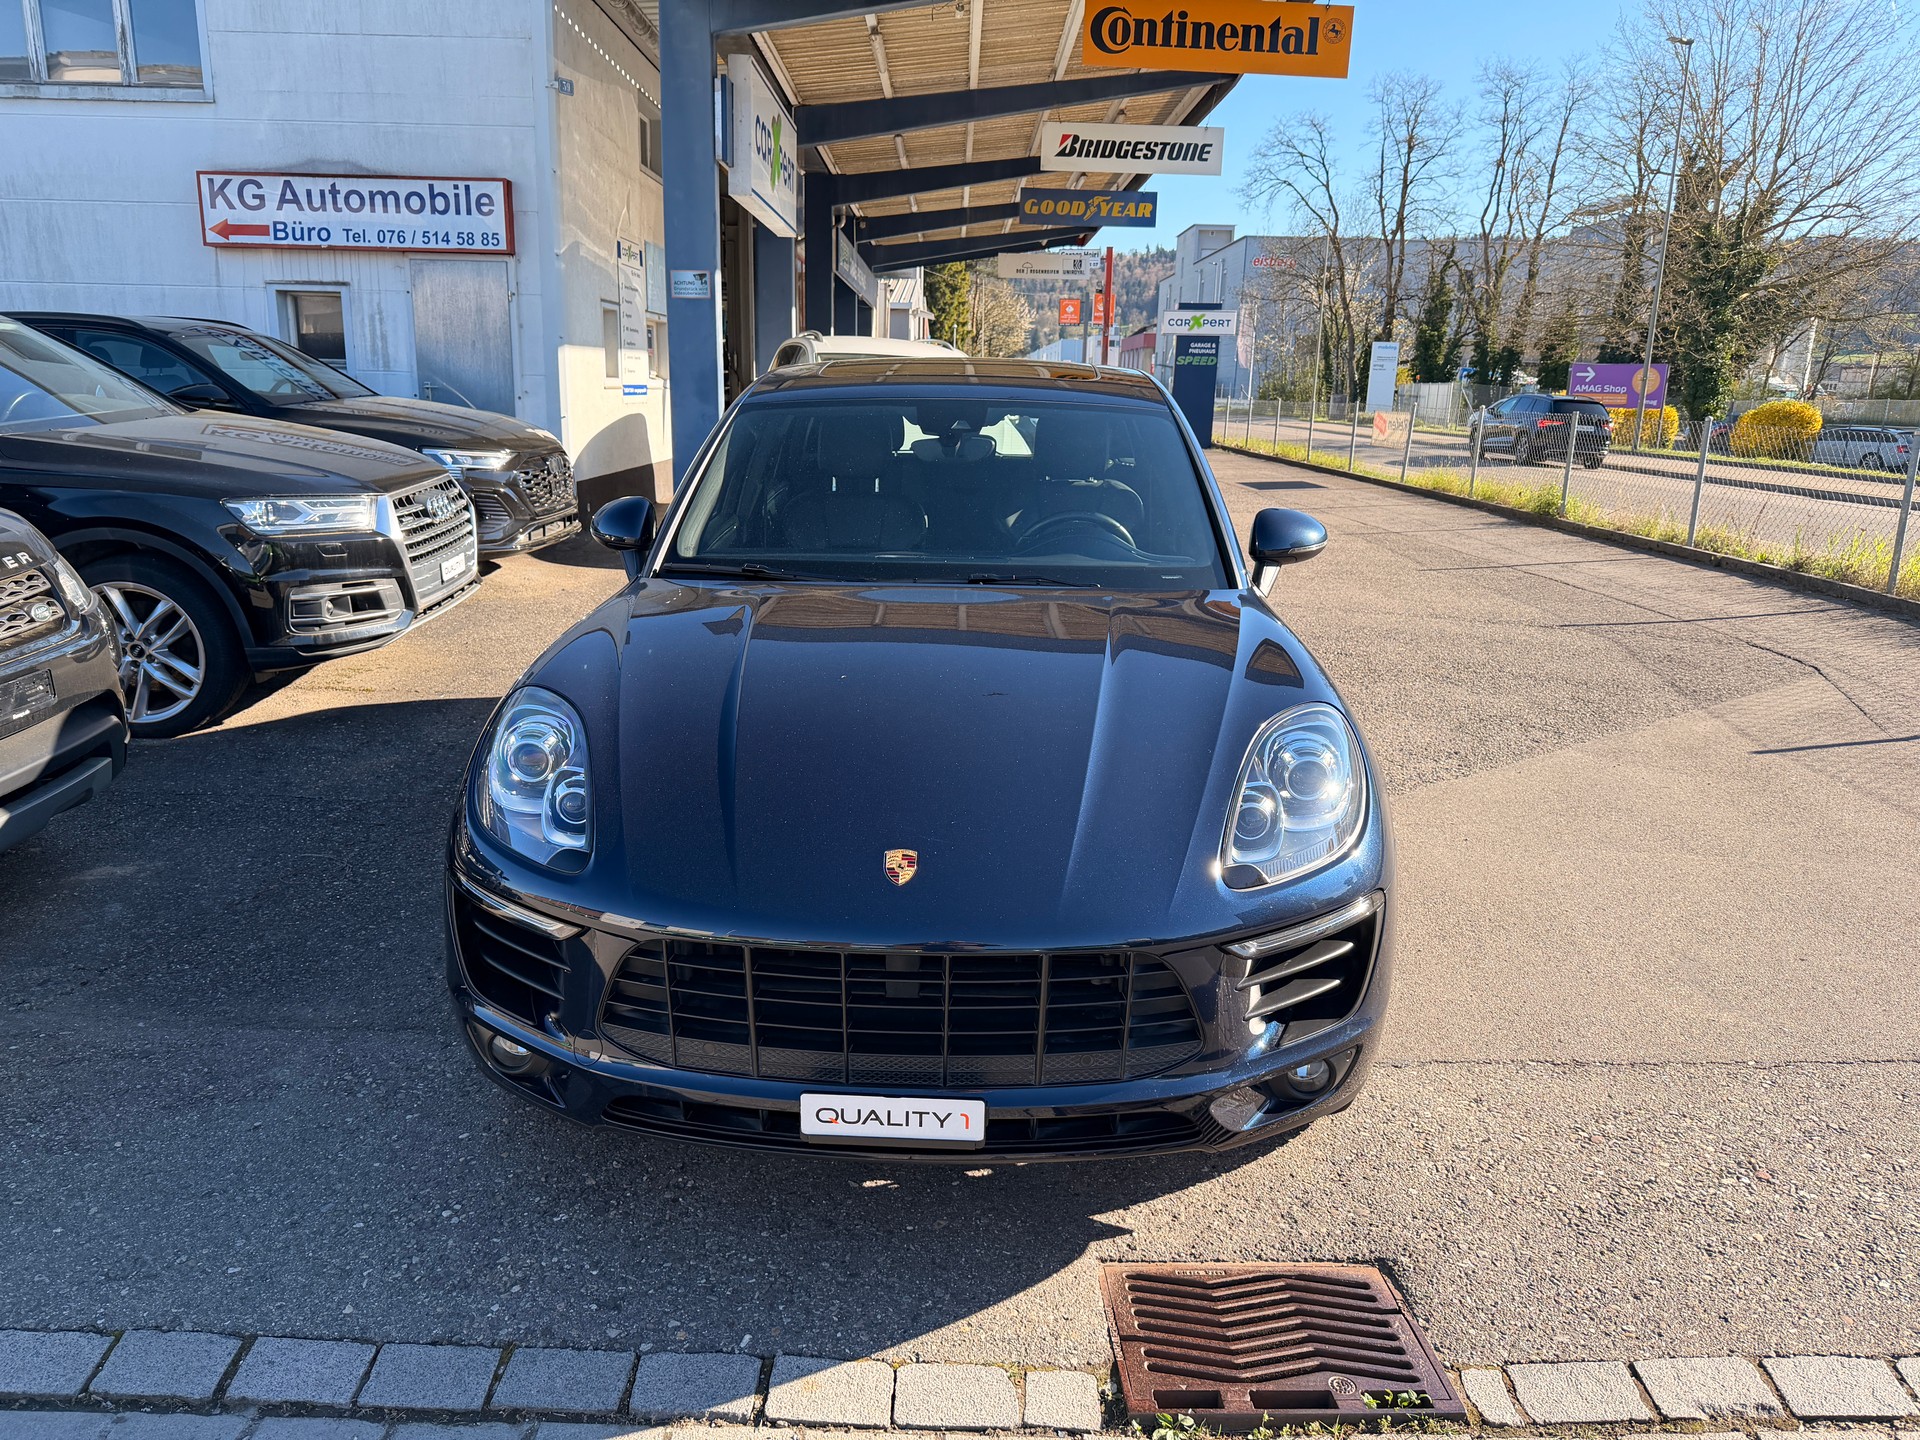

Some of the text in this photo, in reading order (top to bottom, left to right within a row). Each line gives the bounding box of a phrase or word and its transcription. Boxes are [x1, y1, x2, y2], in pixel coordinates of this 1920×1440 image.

[1090, 6, 1320, 55] Continental
[1054, 133, 1213, 162] BRIDGESTONE
[207, 178, 495, 216] KG Automobile
[272, 221, 500, 247] Büro Tel. 076 / 514 58 85
[1176, 355, 1217, 365] SPEED
[1574, 384, 1627, 394] AMAG Shop
[815, 1107, 970, 1130] QUALITY 1
